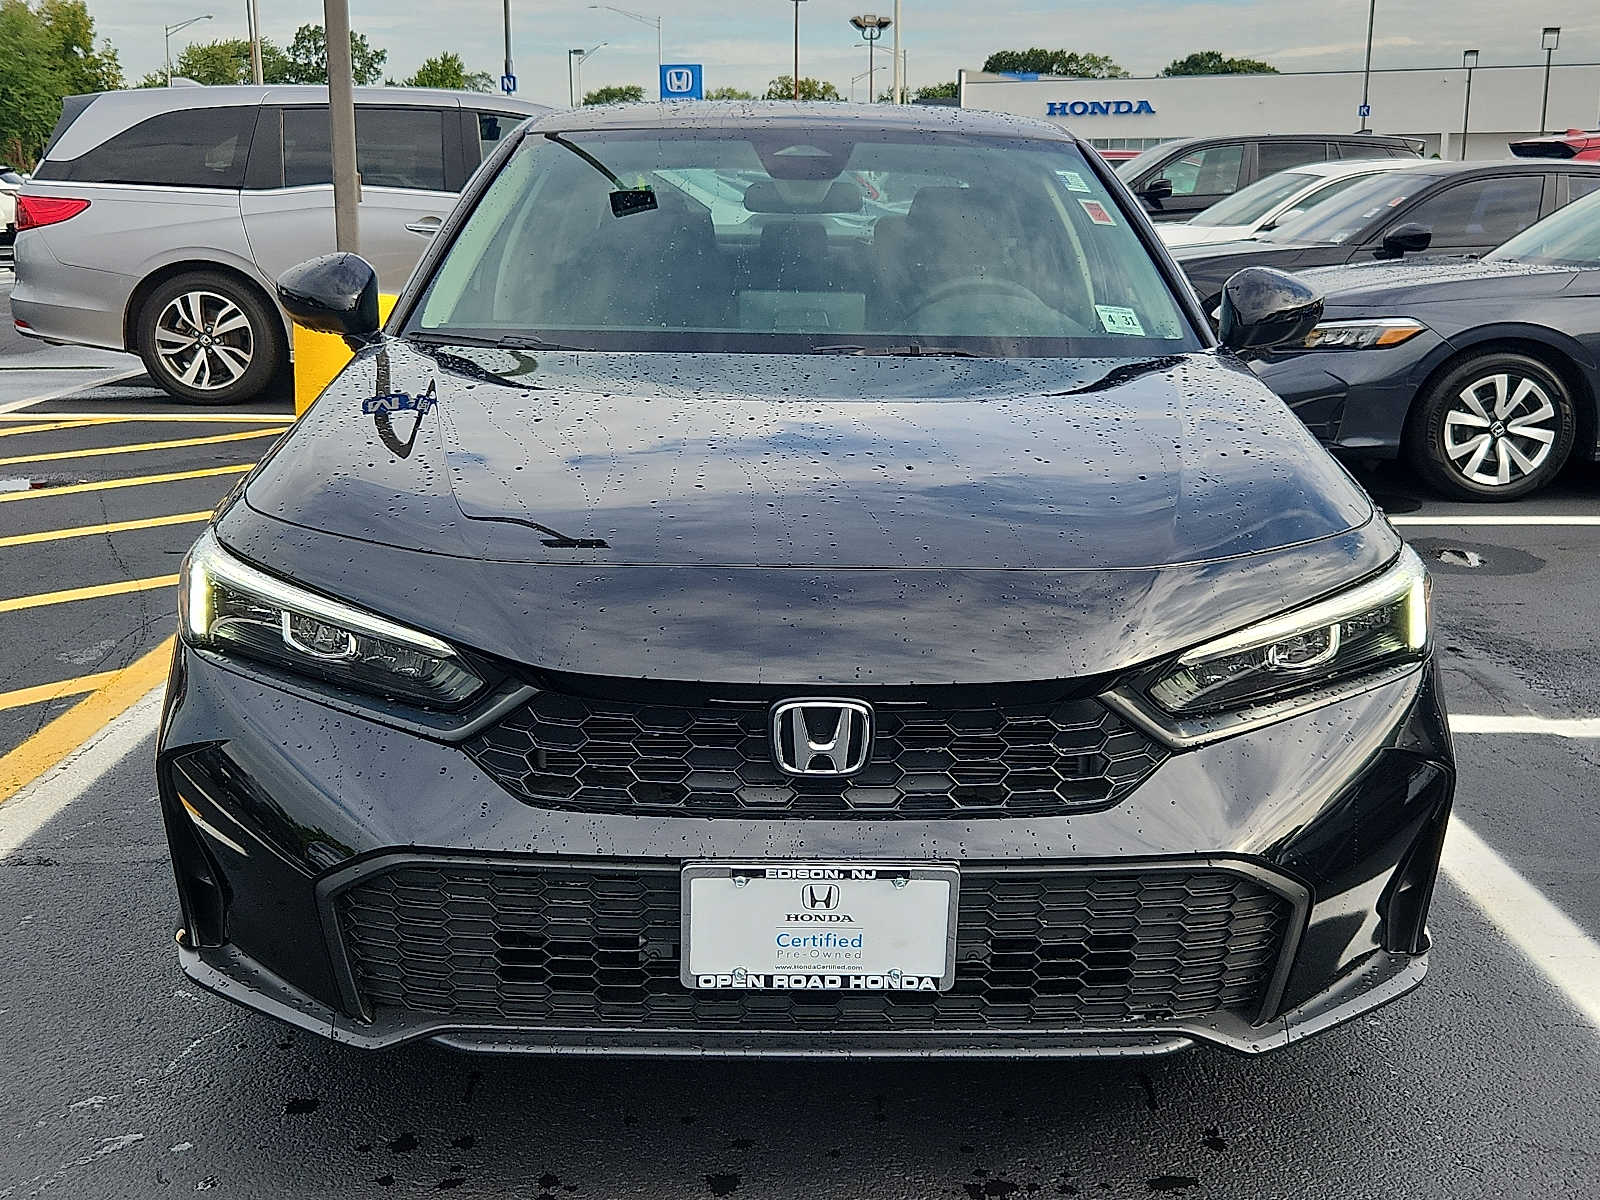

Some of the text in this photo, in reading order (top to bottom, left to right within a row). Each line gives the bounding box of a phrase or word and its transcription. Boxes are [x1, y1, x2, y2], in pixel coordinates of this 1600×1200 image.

[503, 77, 514, 91] N
[1046, 100, 1156, 117] HONDA
[1360, 106, 1369, 116] K
[1107, 314, 1137, 327] 4 31
[765, 868, 877, 880] EDISON, NJ
[785, 914, 855, 923] HONDA
[776, 932, 863, 948] Certified
[777, 949, 862, 959] Pre-Owned
[698, 975, 937, 990] OPEN ROAD HONDA
